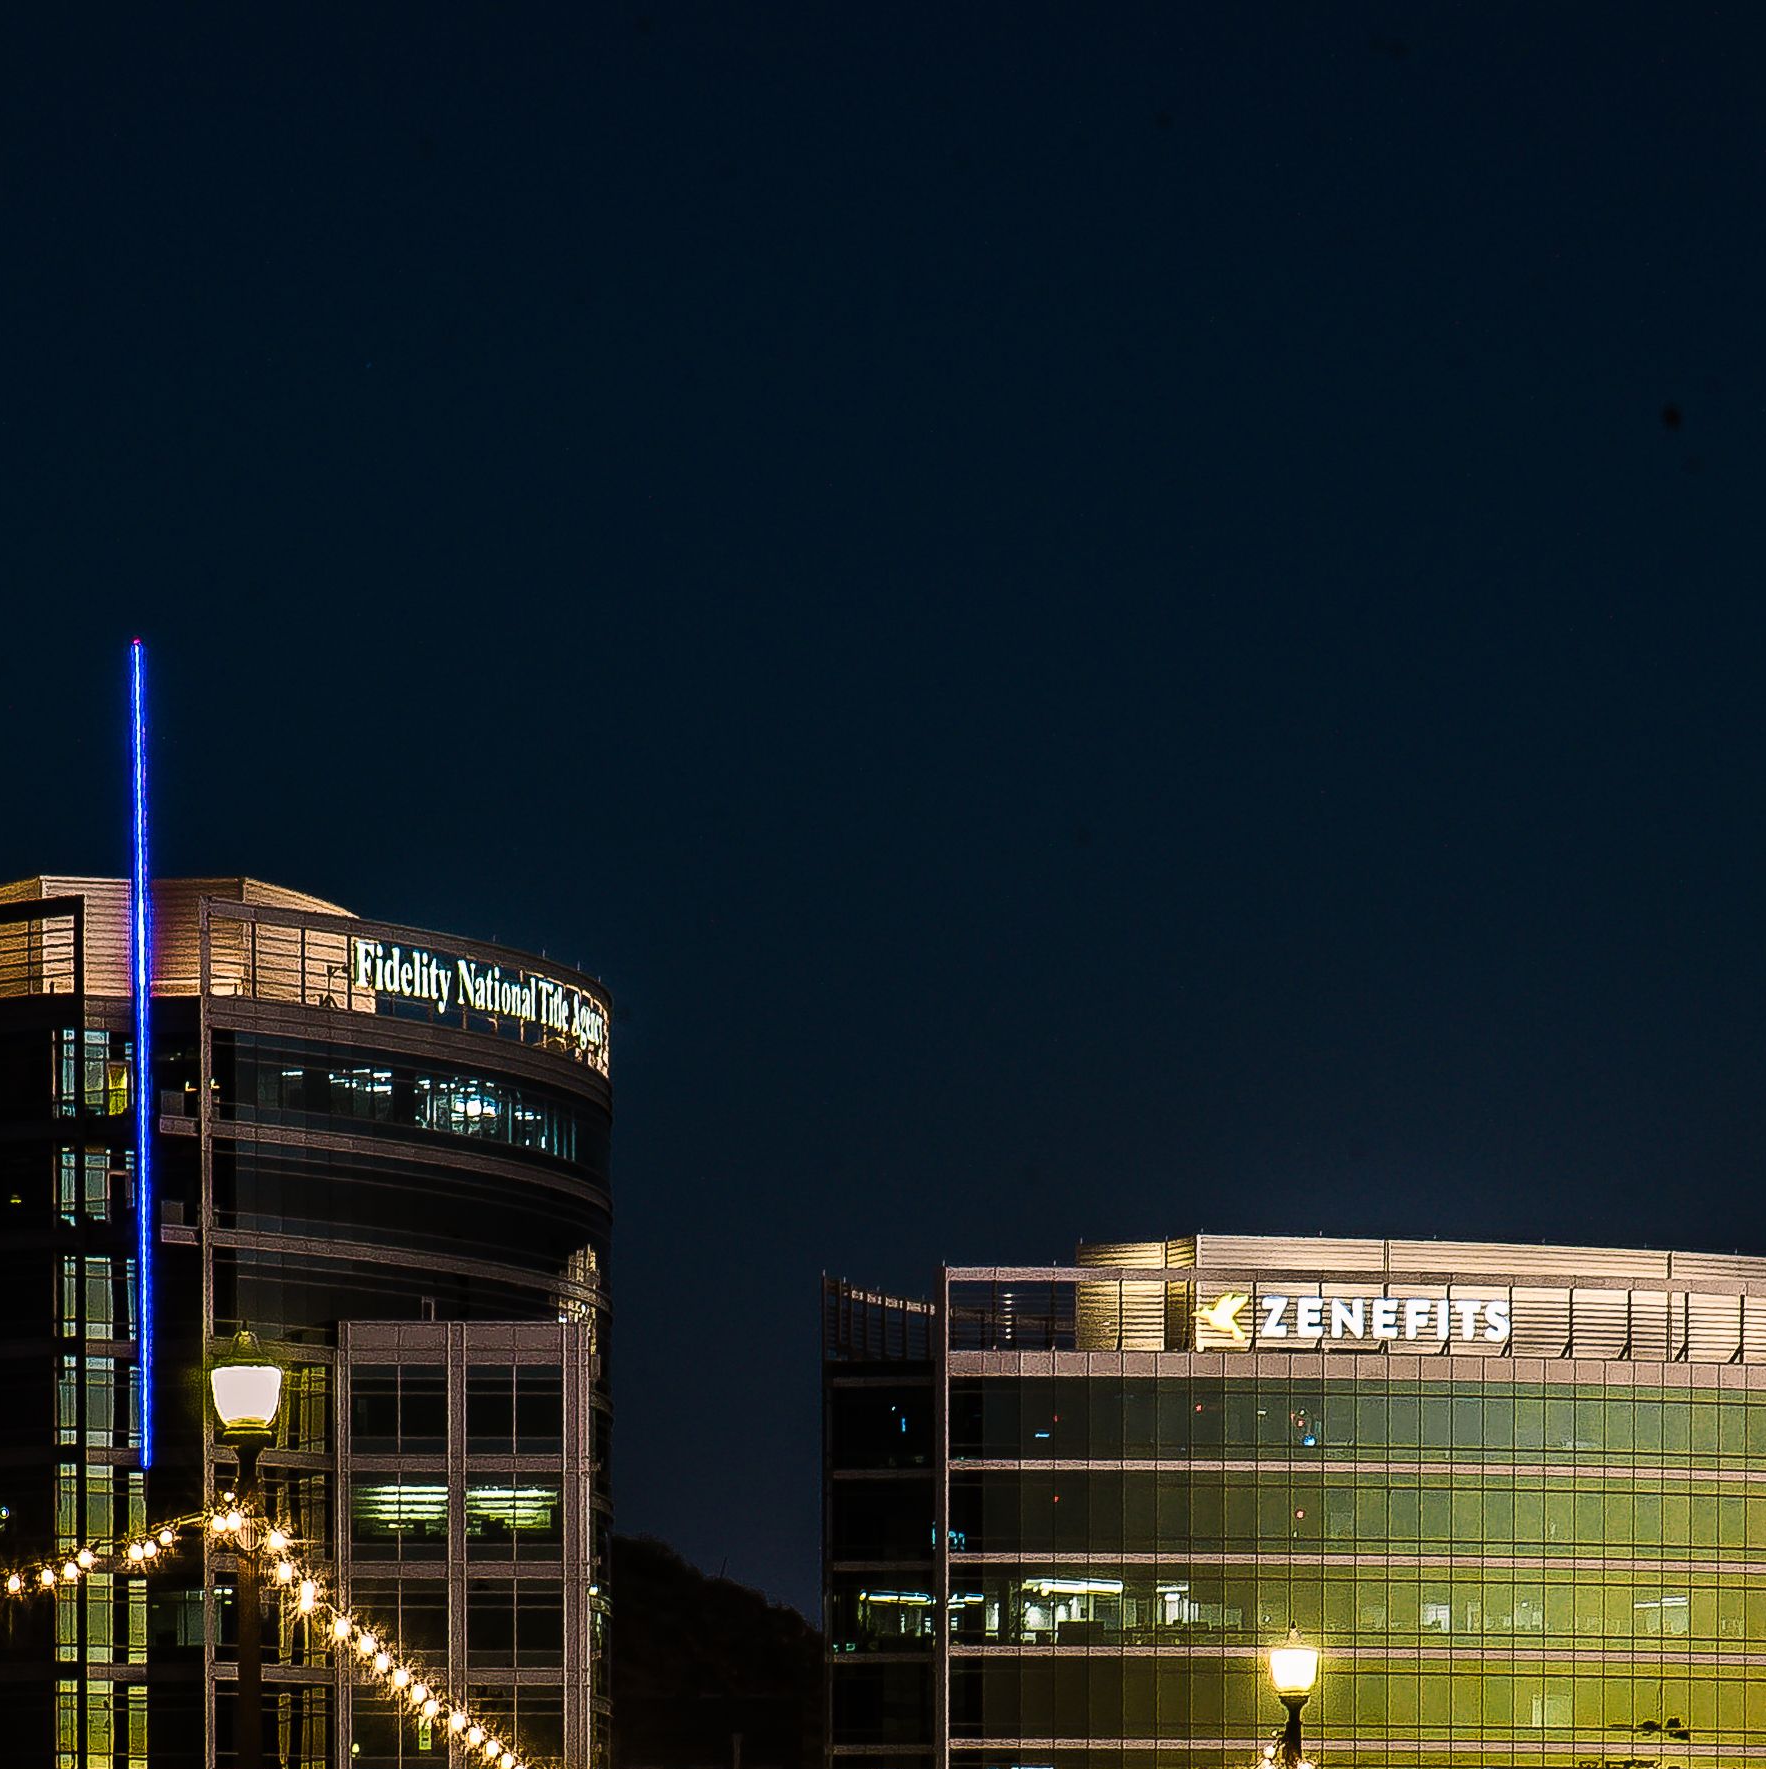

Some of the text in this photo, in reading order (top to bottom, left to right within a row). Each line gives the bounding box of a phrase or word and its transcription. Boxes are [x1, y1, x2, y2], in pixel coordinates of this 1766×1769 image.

[354, 940, 451, 1015] Fidelity
[456, 959, 537, 1023] National
[537, 979, 570, 1033] Title
[1260, 1294, 1511, 1343] ZENEFITS
